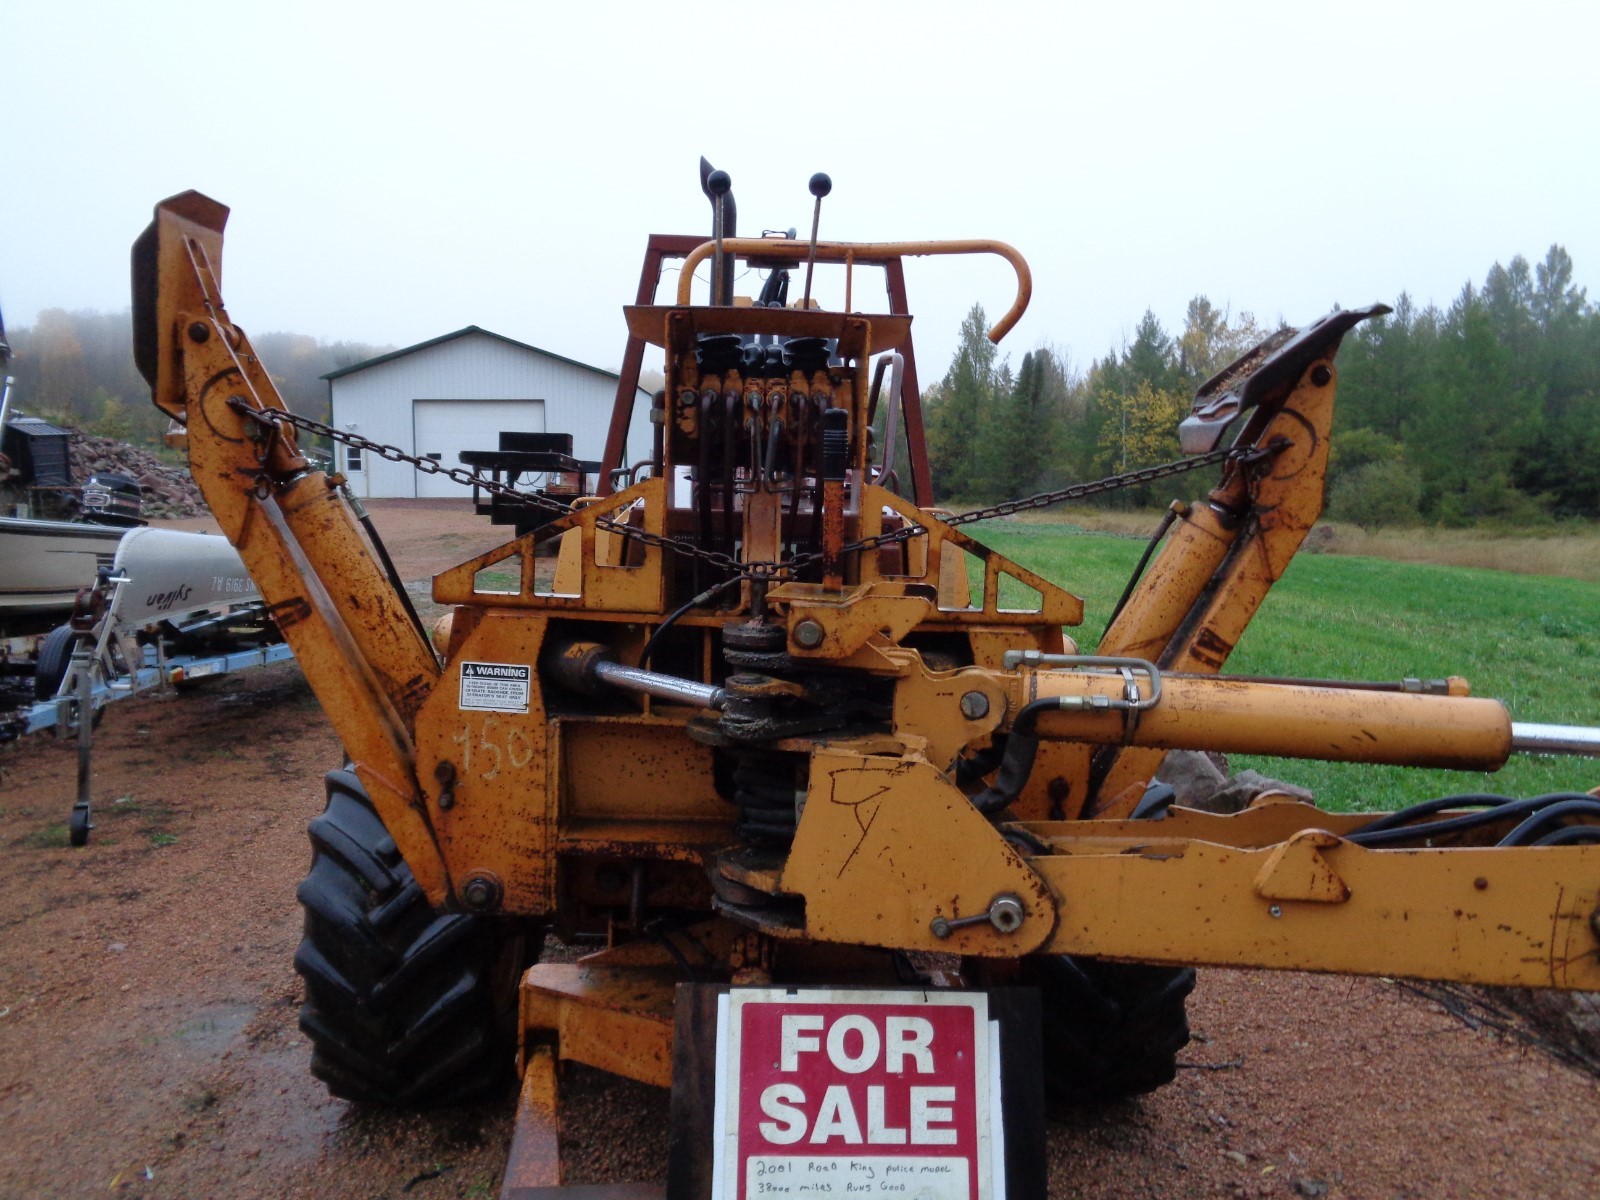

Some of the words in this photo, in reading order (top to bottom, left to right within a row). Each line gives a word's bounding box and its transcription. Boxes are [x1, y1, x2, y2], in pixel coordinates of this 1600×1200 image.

[211, 576, 224, 592] AL
[225, 577, 243, 593] 3919
[476, 666, 526, 678] WARNING
[780, 1014, 935, 1075] FOR
[758, 1083, 958, 1145] SALE
[756, 1161, 792, 1176] 2001
[850, 1161, 876, 1178] King
[886, 1165, 914, 1175] police
[757, 1183, 790, 1193] 38000
